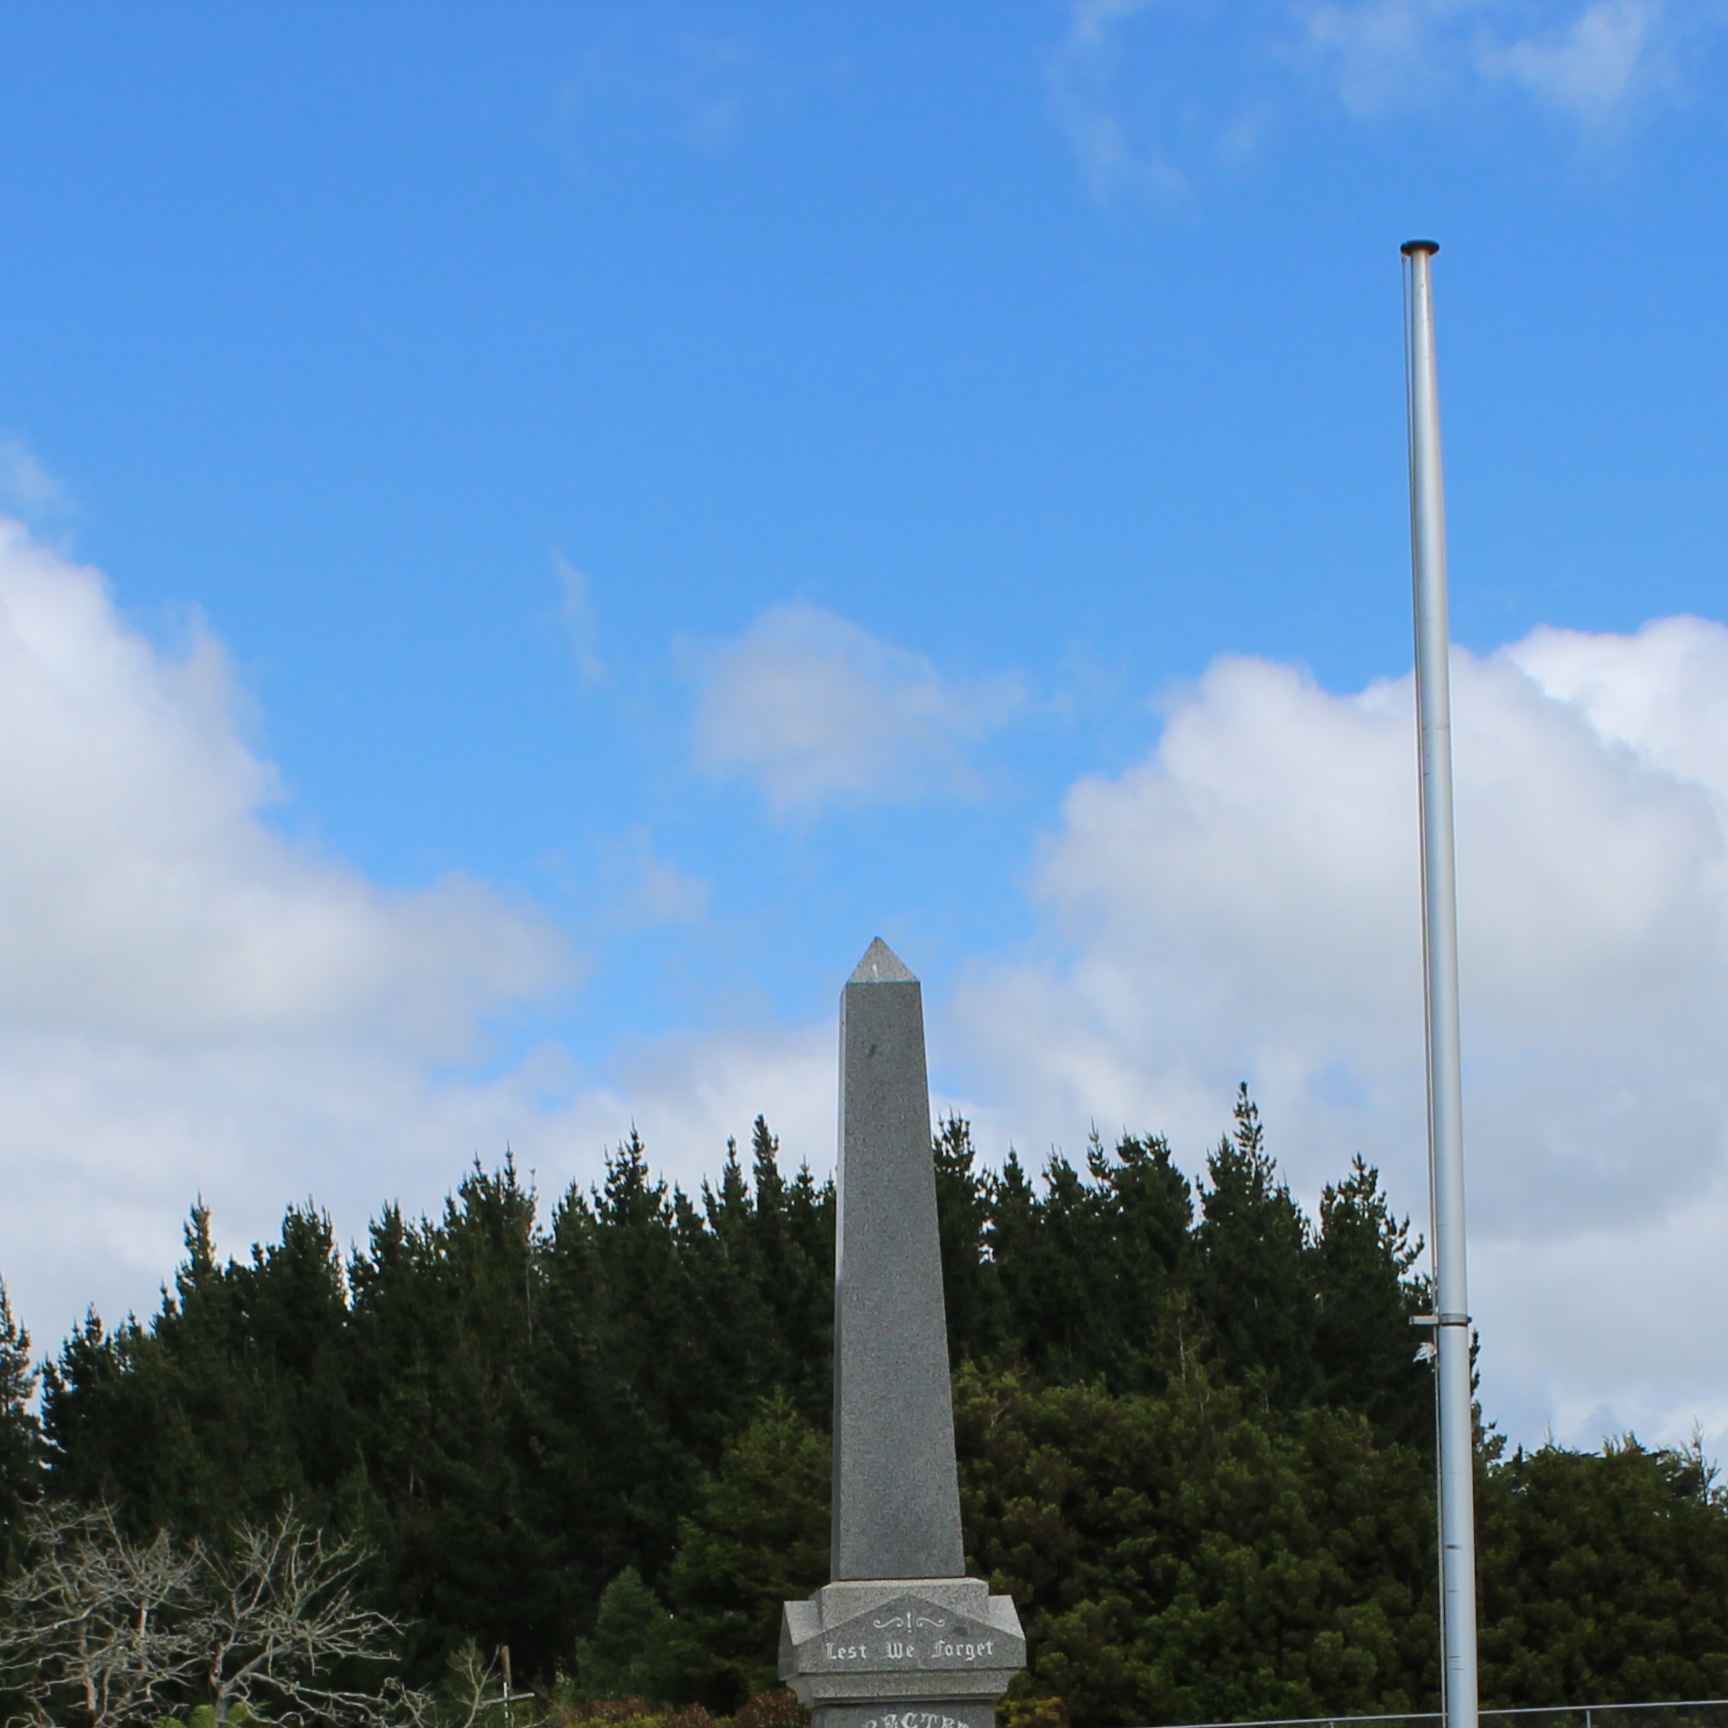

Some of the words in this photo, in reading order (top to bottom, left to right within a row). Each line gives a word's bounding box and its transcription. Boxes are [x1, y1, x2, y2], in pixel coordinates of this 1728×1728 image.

[826, 1643, 867, 1660] Lest
[886, 1641, 915, 1659] We
[931, 1640, 994, 1662] Forget
